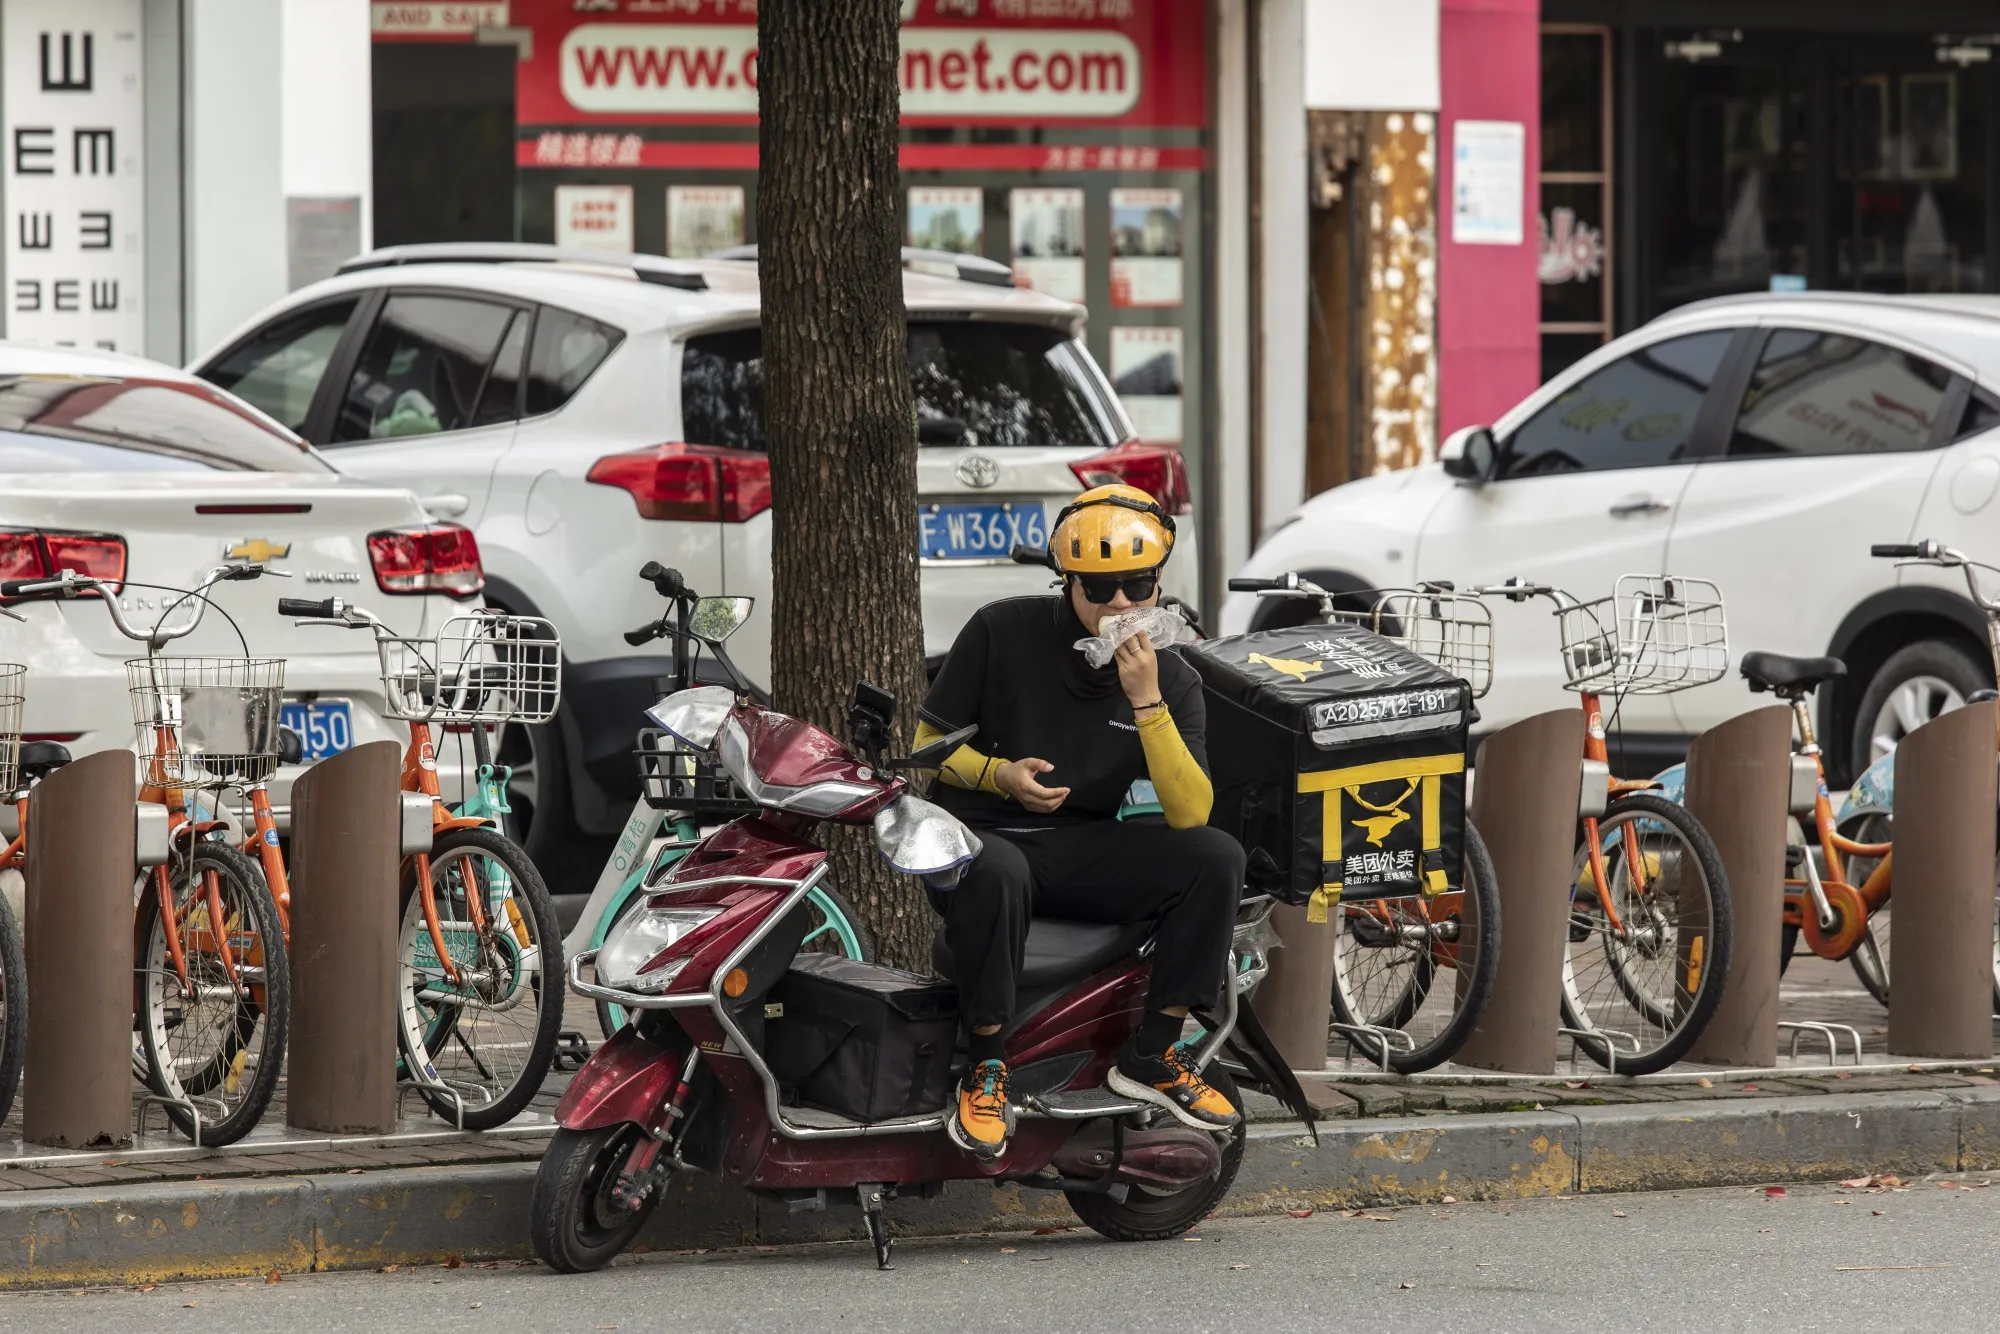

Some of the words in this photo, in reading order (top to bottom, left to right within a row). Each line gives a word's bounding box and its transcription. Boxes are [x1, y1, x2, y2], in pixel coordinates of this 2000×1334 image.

[384, 7, 431, 26] AND
[1325, 692, 1446, 723] A2025712-191
[1344, 849, 1415, 875] 美团外卖
[1344, 874, 1381, 886] 美团外卖
